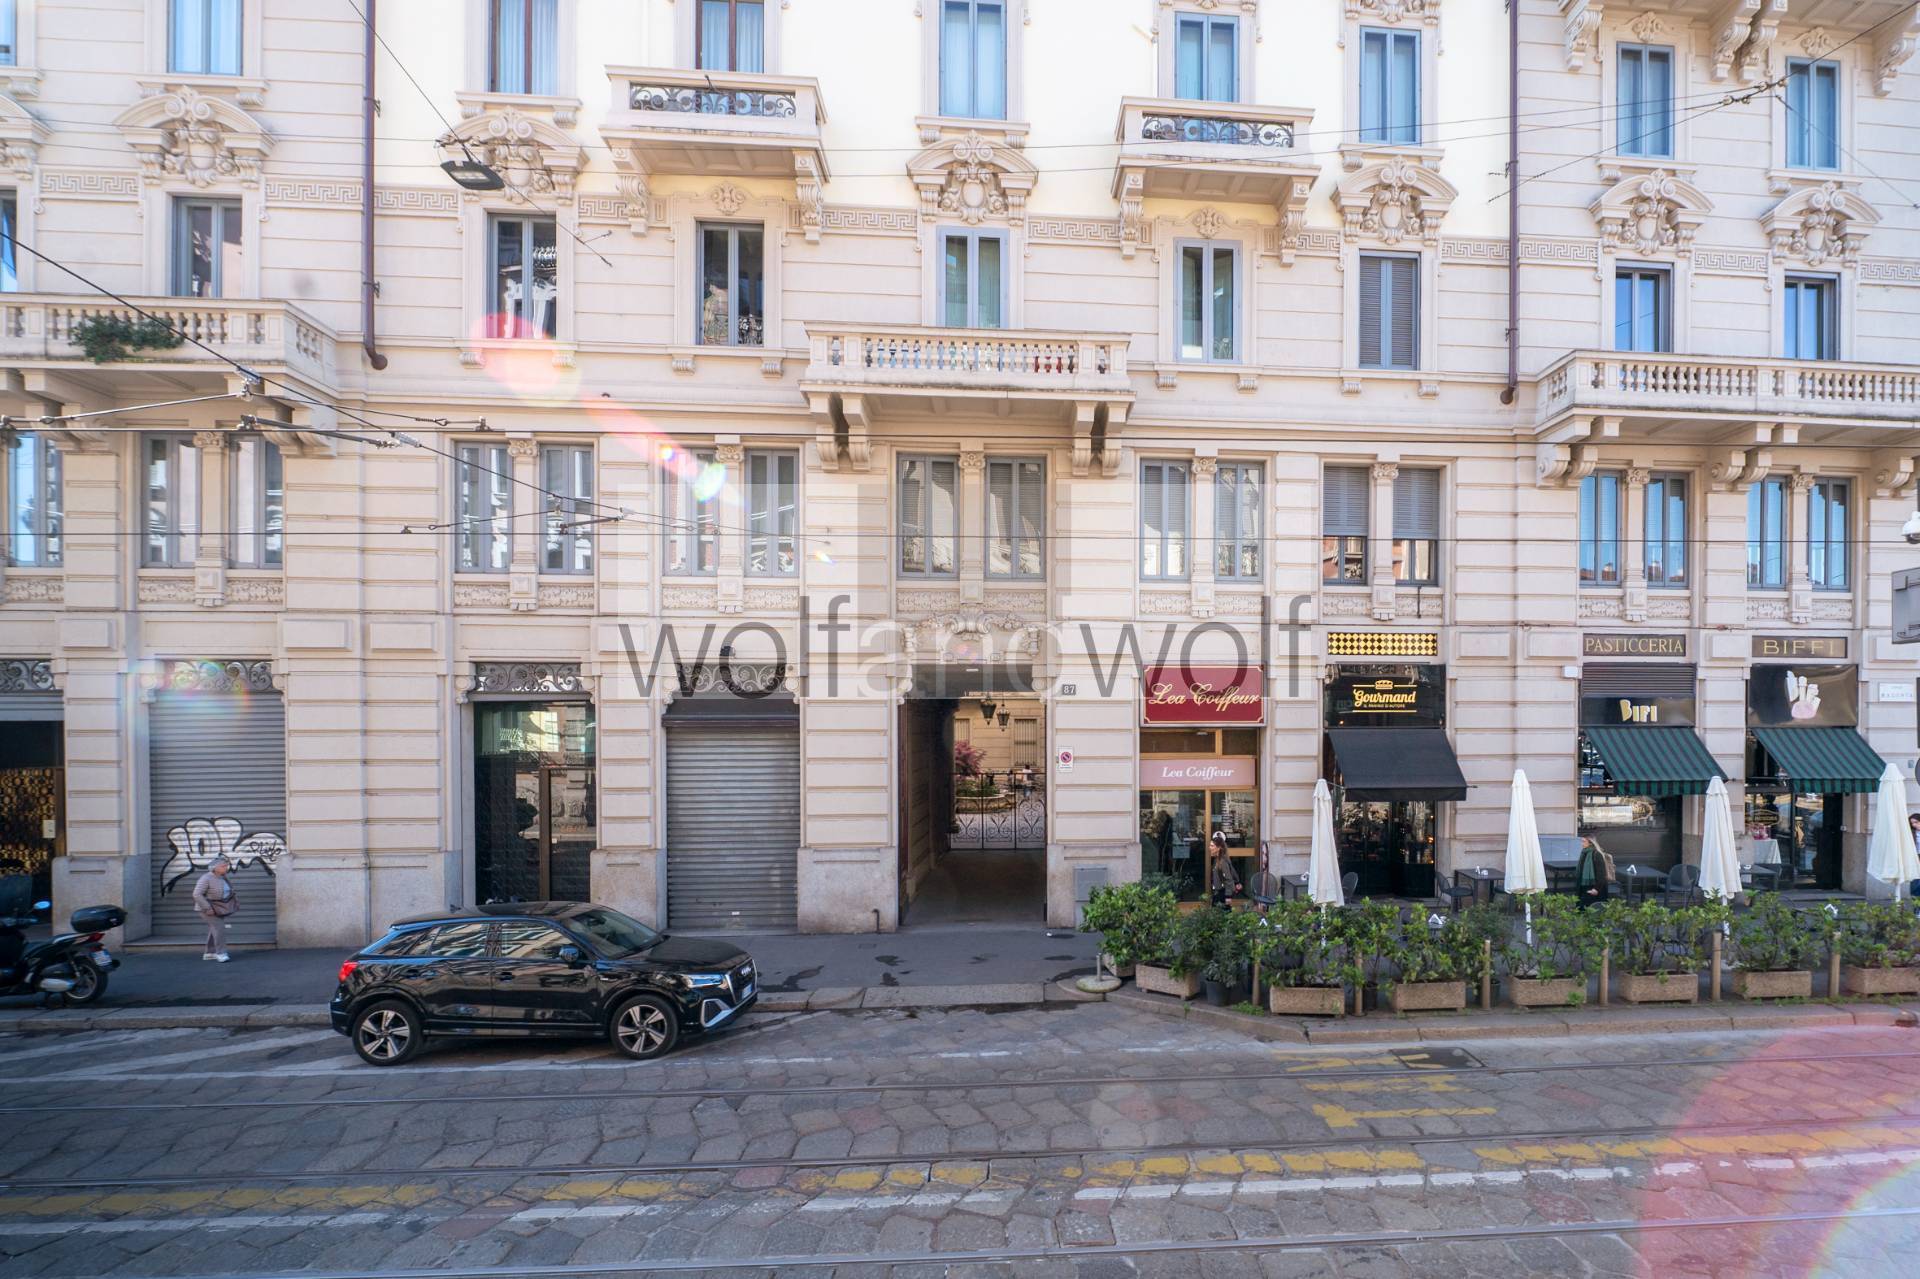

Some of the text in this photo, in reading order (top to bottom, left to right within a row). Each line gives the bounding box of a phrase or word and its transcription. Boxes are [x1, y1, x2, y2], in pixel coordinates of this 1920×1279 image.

[1584, 638, 1683, 653] PASTICCERIA
[1763, 640, 1834, 655] BIFFI
[1063, 685, 1075, 694] 87
[1148, 682, 1260, 711] Lea Coiffeur
[1353, 688, 1417, 707] Gourmand
[1161, 766, 1234, 780] Lea Coiffeur
